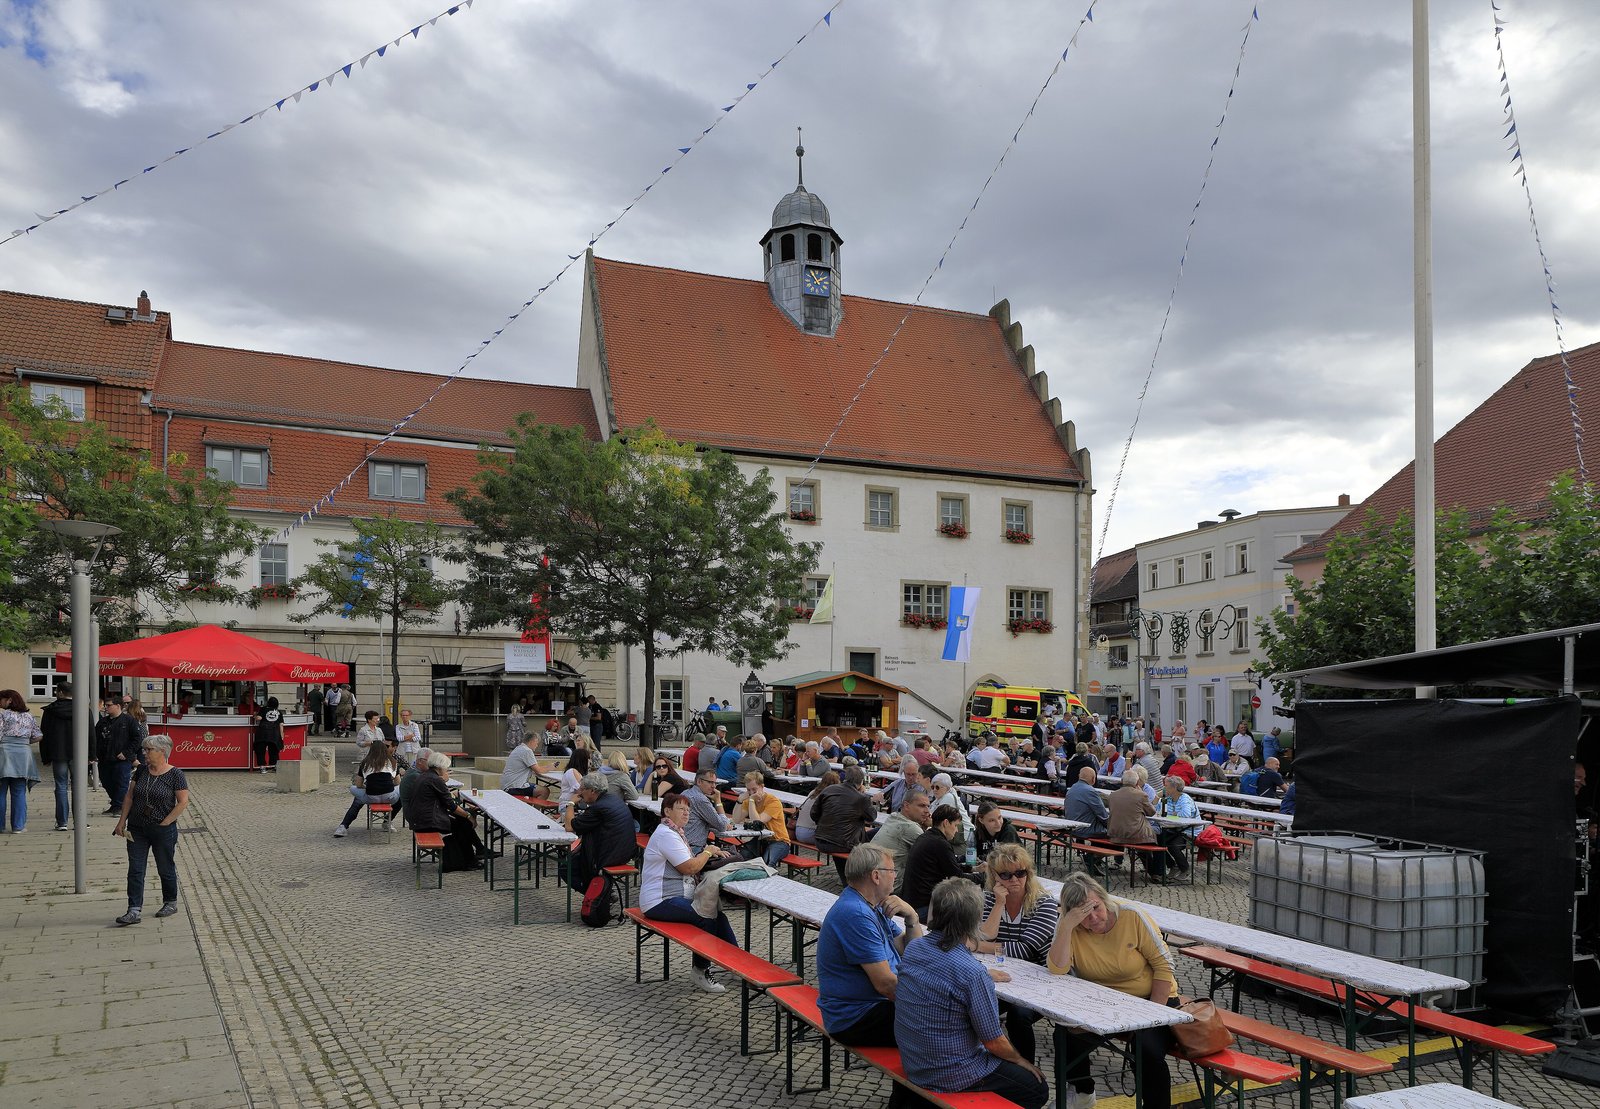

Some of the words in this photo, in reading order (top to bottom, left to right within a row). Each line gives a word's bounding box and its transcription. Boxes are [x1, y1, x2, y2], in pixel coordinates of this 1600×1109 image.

[171, 661, 248, 676] Rotkäppchen
[290, 665, 336, 680] Rotkäppchen
[1156, 665, 1188, 675] Volksbank
[175, 740, 241, 755] Rotkäppchen
